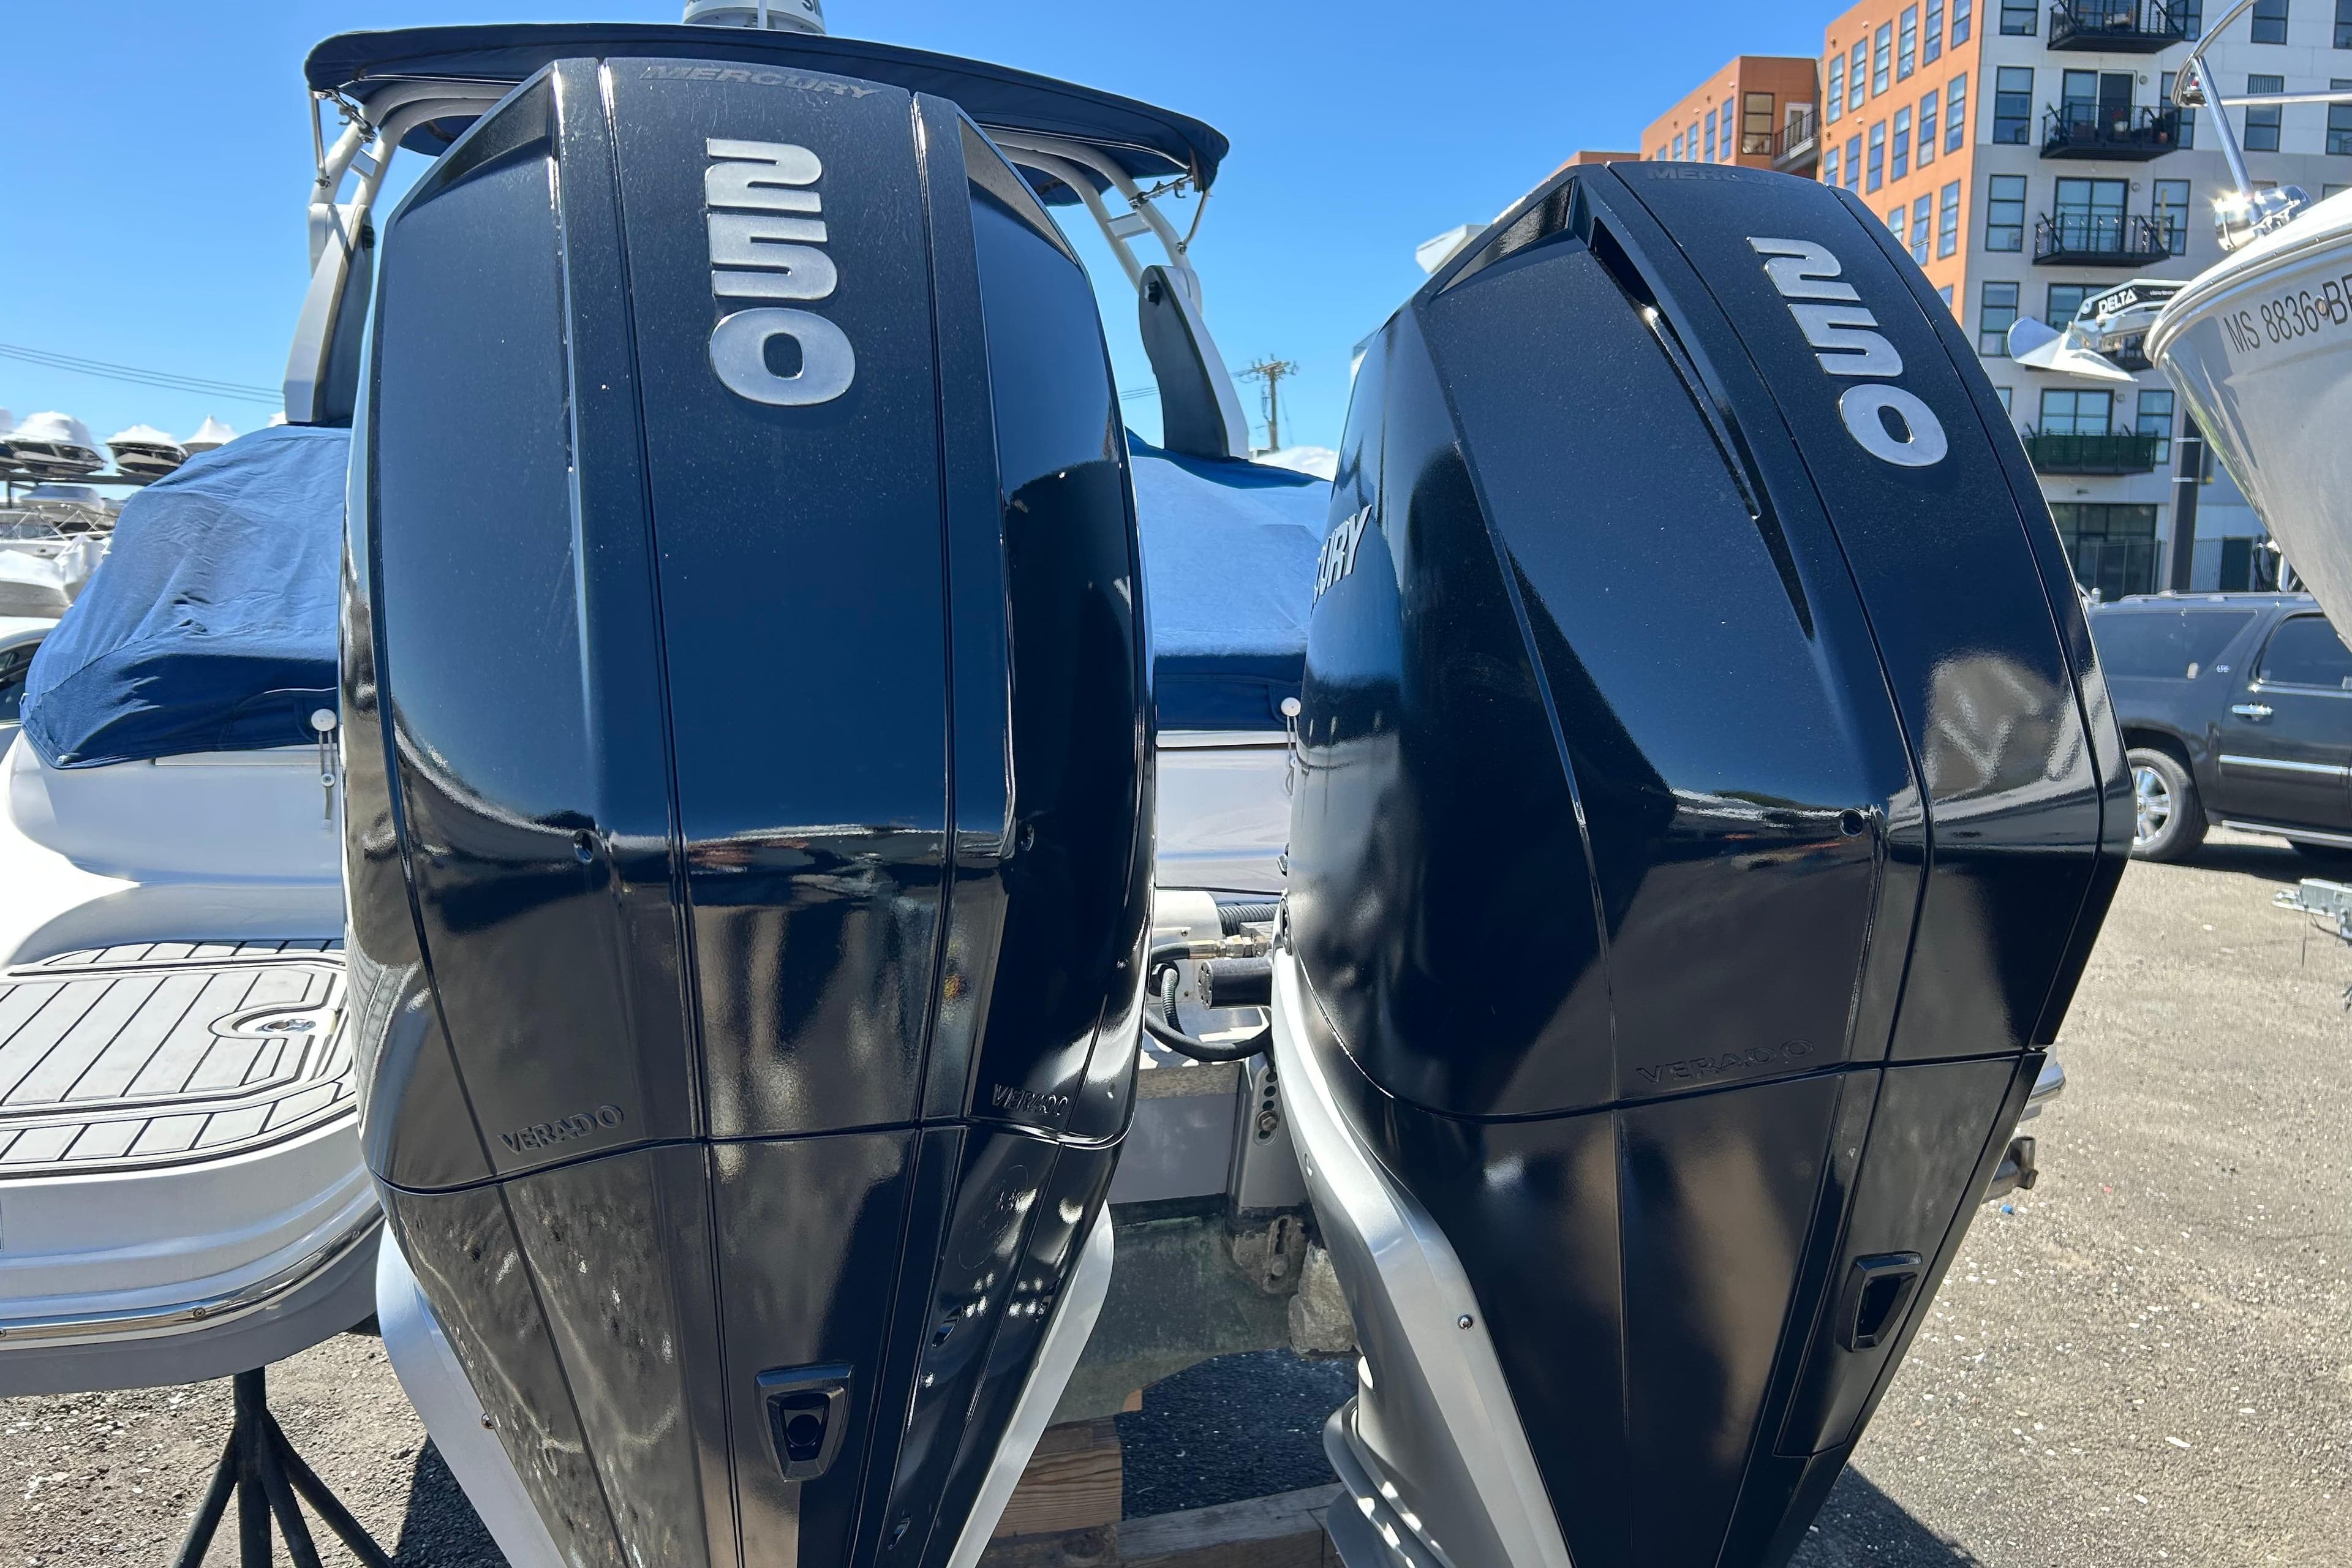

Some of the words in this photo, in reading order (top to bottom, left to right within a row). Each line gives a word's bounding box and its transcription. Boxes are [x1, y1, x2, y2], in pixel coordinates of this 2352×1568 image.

[640, 66, 882, 99] MERCURY
[705, 137, 856, 407] 250
[2098, 288, 2138, 315] DELTA
[2223, 311, 2260, 353] MS
[2260, 290, 2319, 344] 8836
[1746, 236, 1948, 467] 250
[1636, 1039, 1814, 1084] VERADO
[497, 1104, 624, 1155] VERADO
